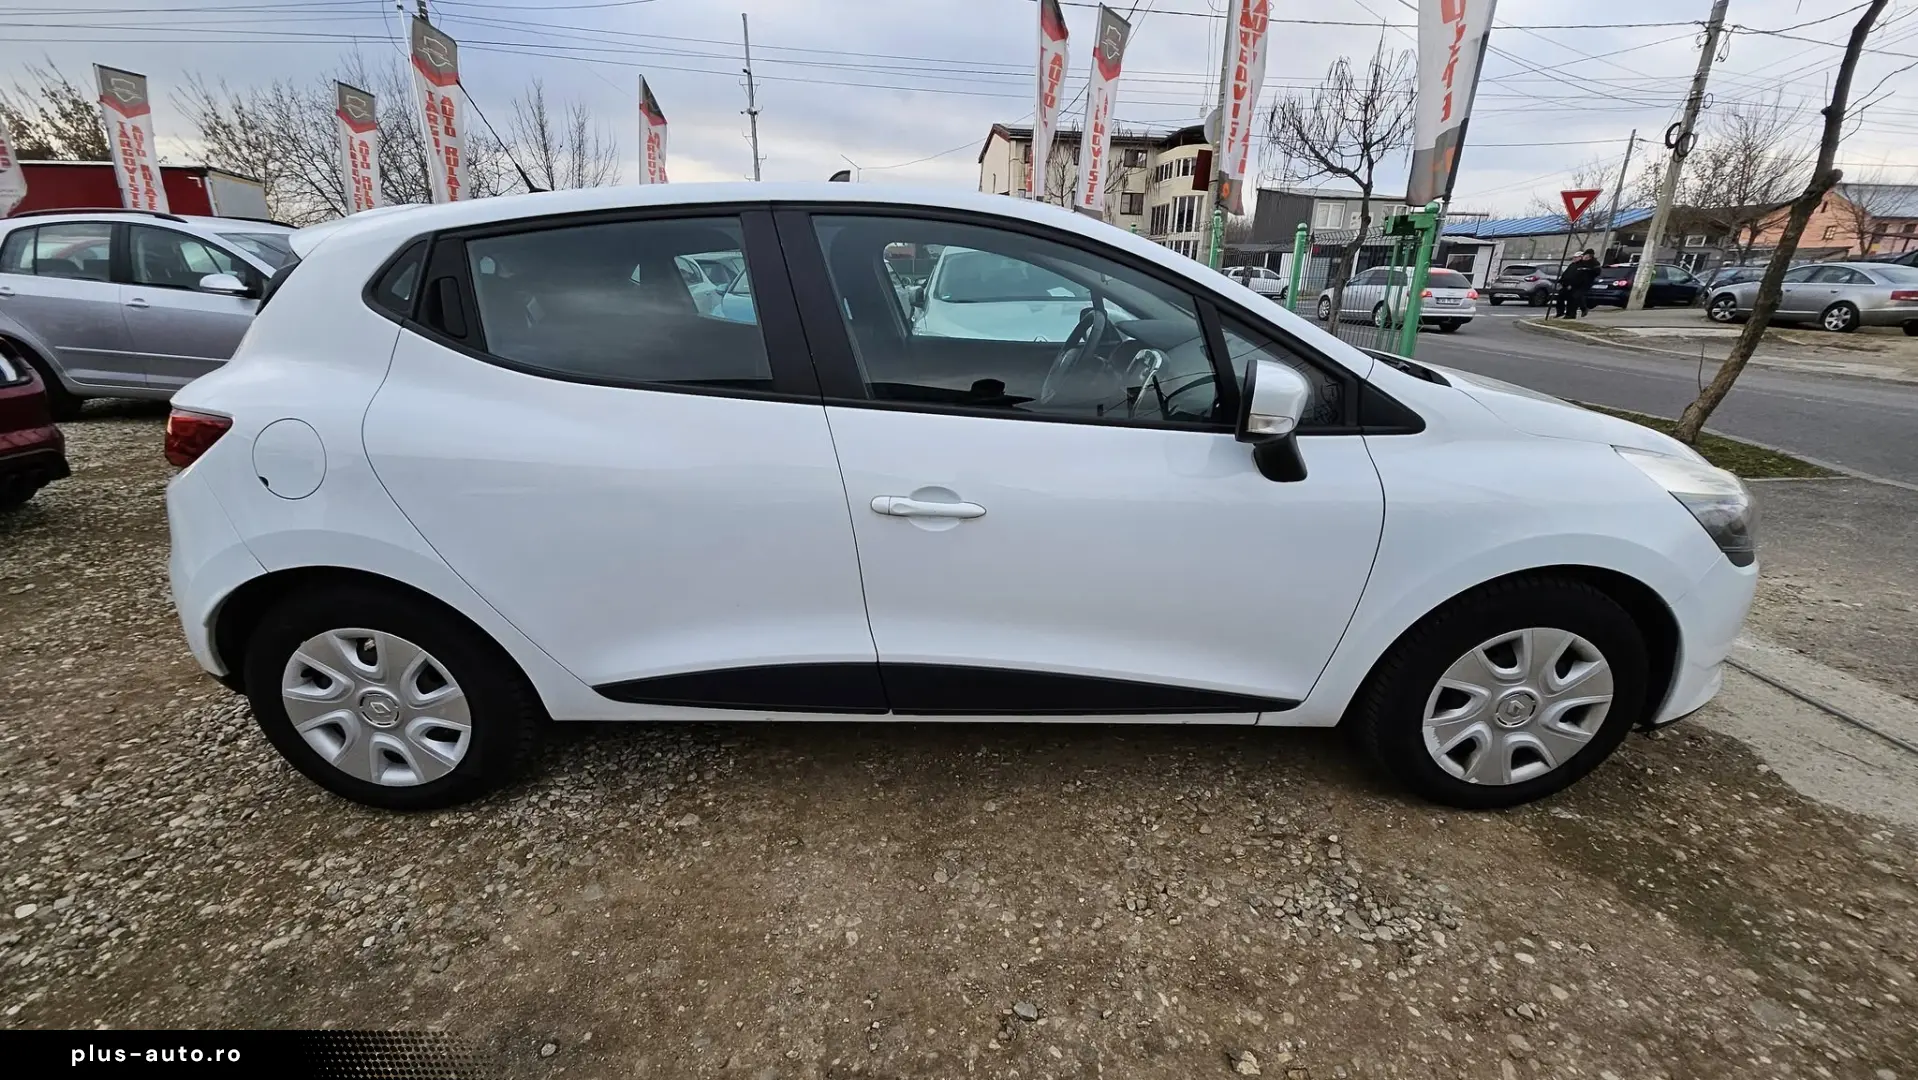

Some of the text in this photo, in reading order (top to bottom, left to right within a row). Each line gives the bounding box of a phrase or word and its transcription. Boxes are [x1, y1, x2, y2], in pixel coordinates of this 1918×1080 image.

[1043, 51, 1063, 108] AUTO
[440, 95, 455, 138] AUTO
[132, 124, 147, 158] AUTO
[358, 139, 371, 170] AUTO
[117, 120, 141, 209] TARGOVISTE
